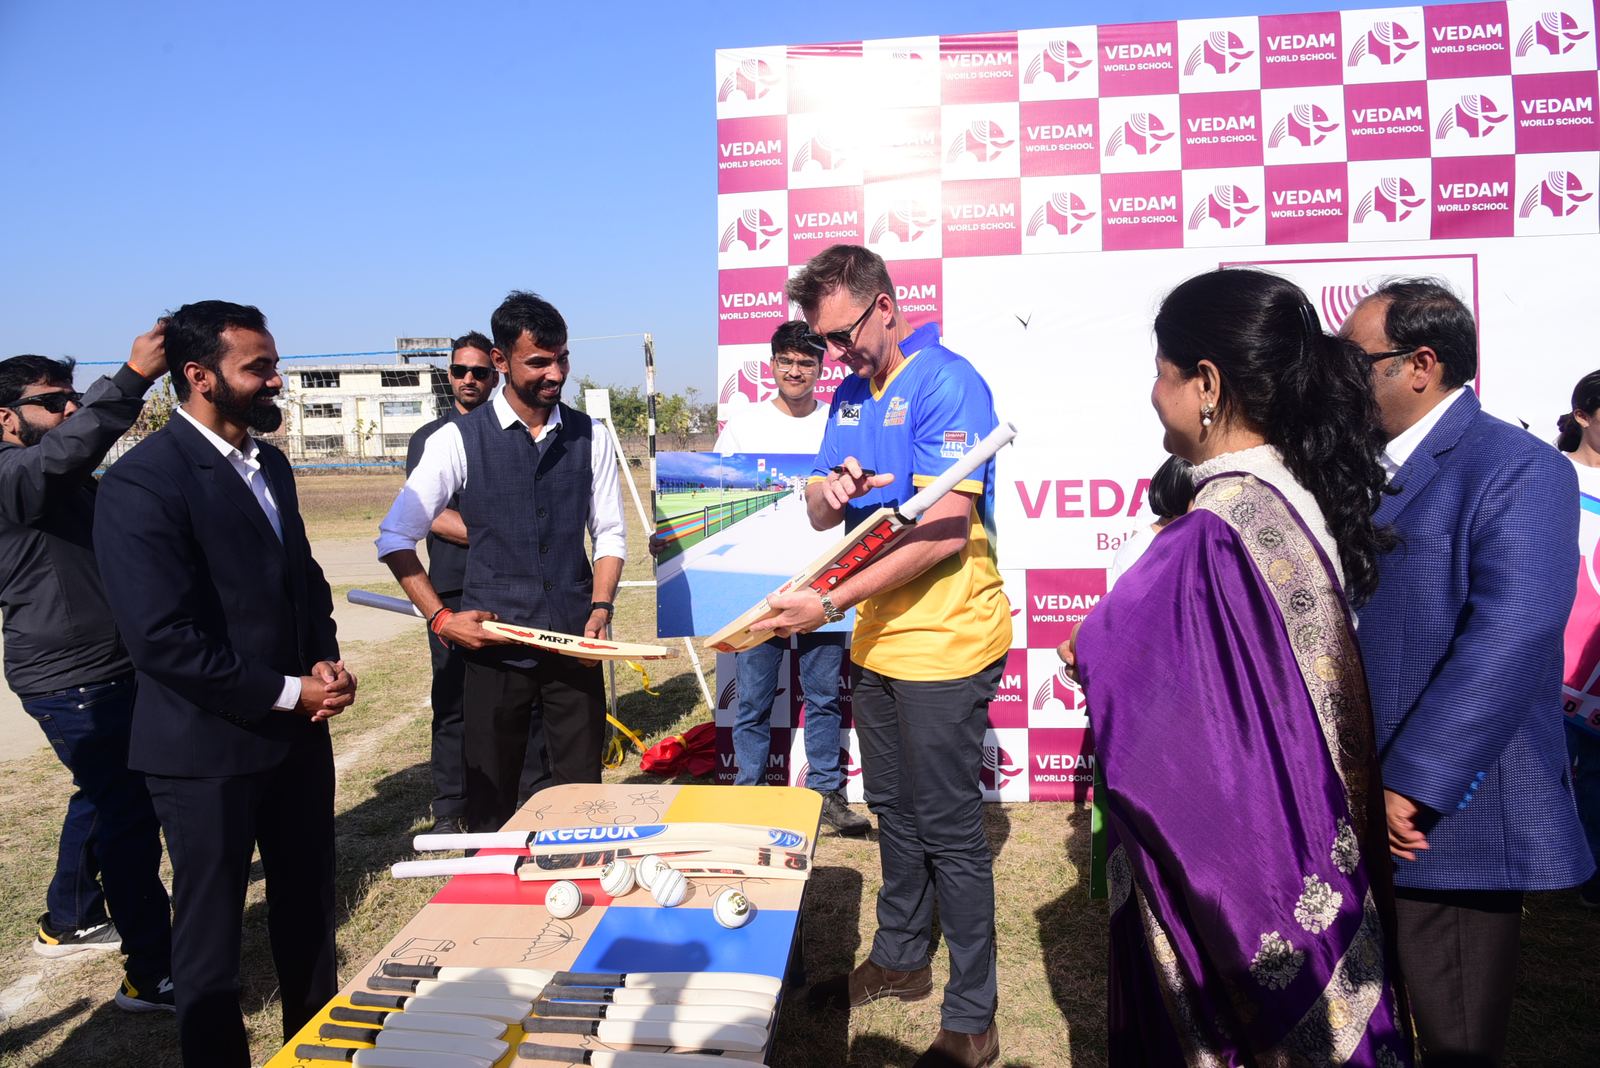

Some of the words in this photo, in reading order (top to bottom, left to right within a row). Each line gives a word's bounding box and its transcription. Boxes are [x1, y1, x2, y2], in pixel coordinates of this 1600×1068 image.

[1432, 24, 1502, 40] VEDAM
[1267, 33, 1335, 50] VEDAM
[1105, 42, 1172, 60] VEDAM
[1432, 45, 1465, 53] WORLD
[1466, 43, 1504, 51] SCHOOL
[947, 52, 1012, 67] VEDAM
[1266, 55, 1299, 63] WORLD
[1300, 53, 1337, 61] SCHOOL
[1104, 64, 1136, 72] WORLD
[1138, 62, 1173, 70] SCHOOL
[978, 70, 1014, 78] SCHOOL
[1521, 97, 1592, 114] VEDAM
[1352, 106, 1422, 123] VEDAM
[1188, 115, 1255, 132] VEDAM
[1520, 118, 1554, 126] WORLD
[1556, 117, 1594, 125] SCHOOL
[1027, 123, 1093, 140] VEDAM
[1352, 128, 1385, 136] WORLD
[1387, 126, 1424, 134] SCHOOL
[1186, 136, 1219, 144] WORLD
[1220, 134, 1257, 142] SCHOOL
[721, 140, 782, 157] VEDAM
[1025, 144, 1057, 152] WORLD
[1058, 142, 1094, 151] SCHOOL
[719, 161, 748, 169] WORLD
[750, 158, 783, 167] SCHOOL
[1439, 182, 1508, 198] VEDAM
[1272, 188, 1341, 205] VEDAM
[1109, 195, 1176, 212] VEDAM
[1437, 204, 1470, 212] WORLD
[1472, 202, 1508, 210] SCHOOL
[949, 202, 1014, 219] VEDAM
[1271, 210, 1304, 218] WORLD
[1306, 208, 1342, 216] SCHOOL
[794, 210, 857, 228] VEDAM
[1108, 217, 1140, 225] WORLD
[1141, 215, 1177, 223] SCHOOL
[947, 223, 978, 232] WORLD
[980, 221, 1016, 230] SCHOOL
[793, 232, 824, 240] WORLD
[825, 230, 859, 238] SCHOOL
[896, 284, 936, 300] DAM
[721, 291, 782, 308] VEDAM
[902, 304, 937, 312] SCHOOL
[720, 312, 749, 320] WORLD
[750, 310, 783, 318] SCHOOL
[538, 633, 573, 645] MRF
[993, 694, 1022, 702] CHOOL
[1034, 774, 1067, 782] WORLD
